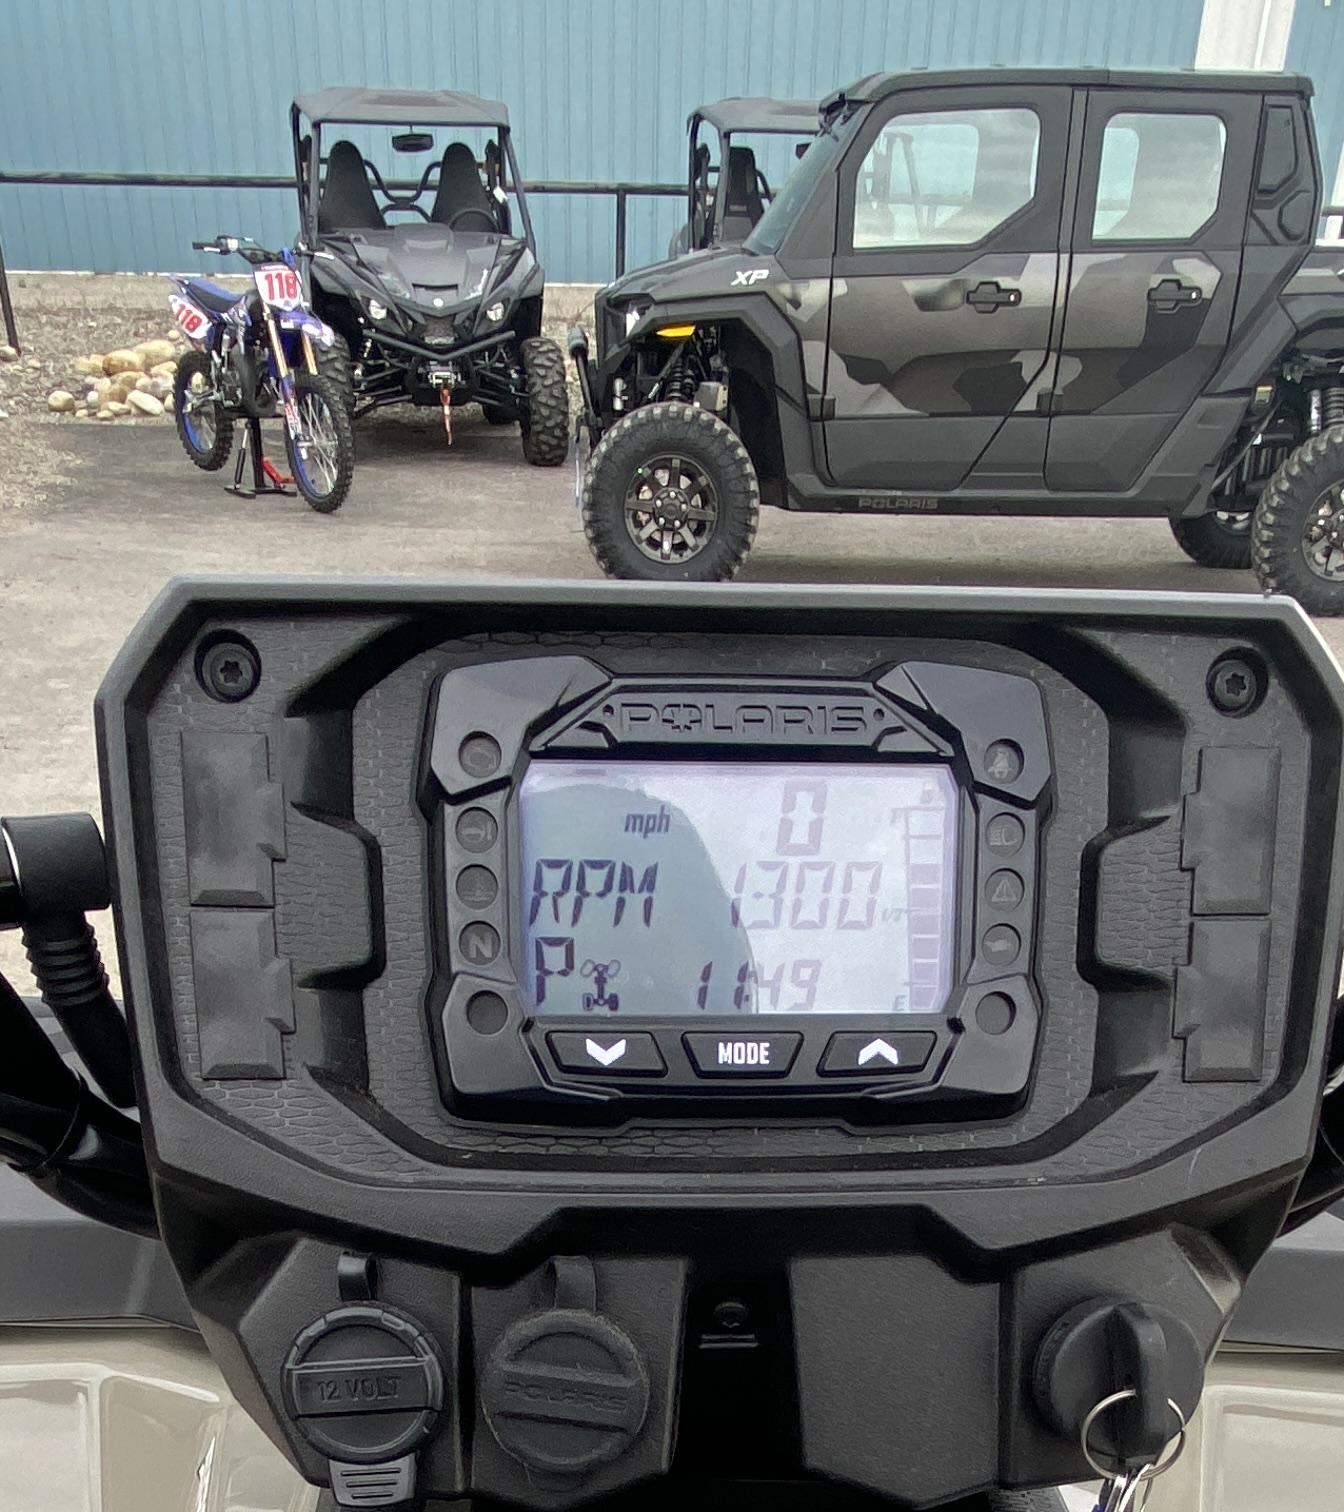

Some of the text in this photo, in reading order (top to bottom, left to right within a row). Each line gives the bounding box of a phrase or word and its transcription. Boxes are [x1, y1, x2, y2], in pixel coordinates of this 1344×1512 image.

[264, 272, 298, 301] 118
[731, 269, 769, 286] XP
[621, 702, 870, 736] POLARIS
[624, 806, 671, 836] mph
[775, 781, 828, 857] 0
[529, 859, 659, 929] RPM
[730, 860, 884, 930] 1300
[534, 936, 574, 1008] P
[717, 1042, 771, 1065] MODE
[317, 1376, 402, 1402] 12 VOLT
